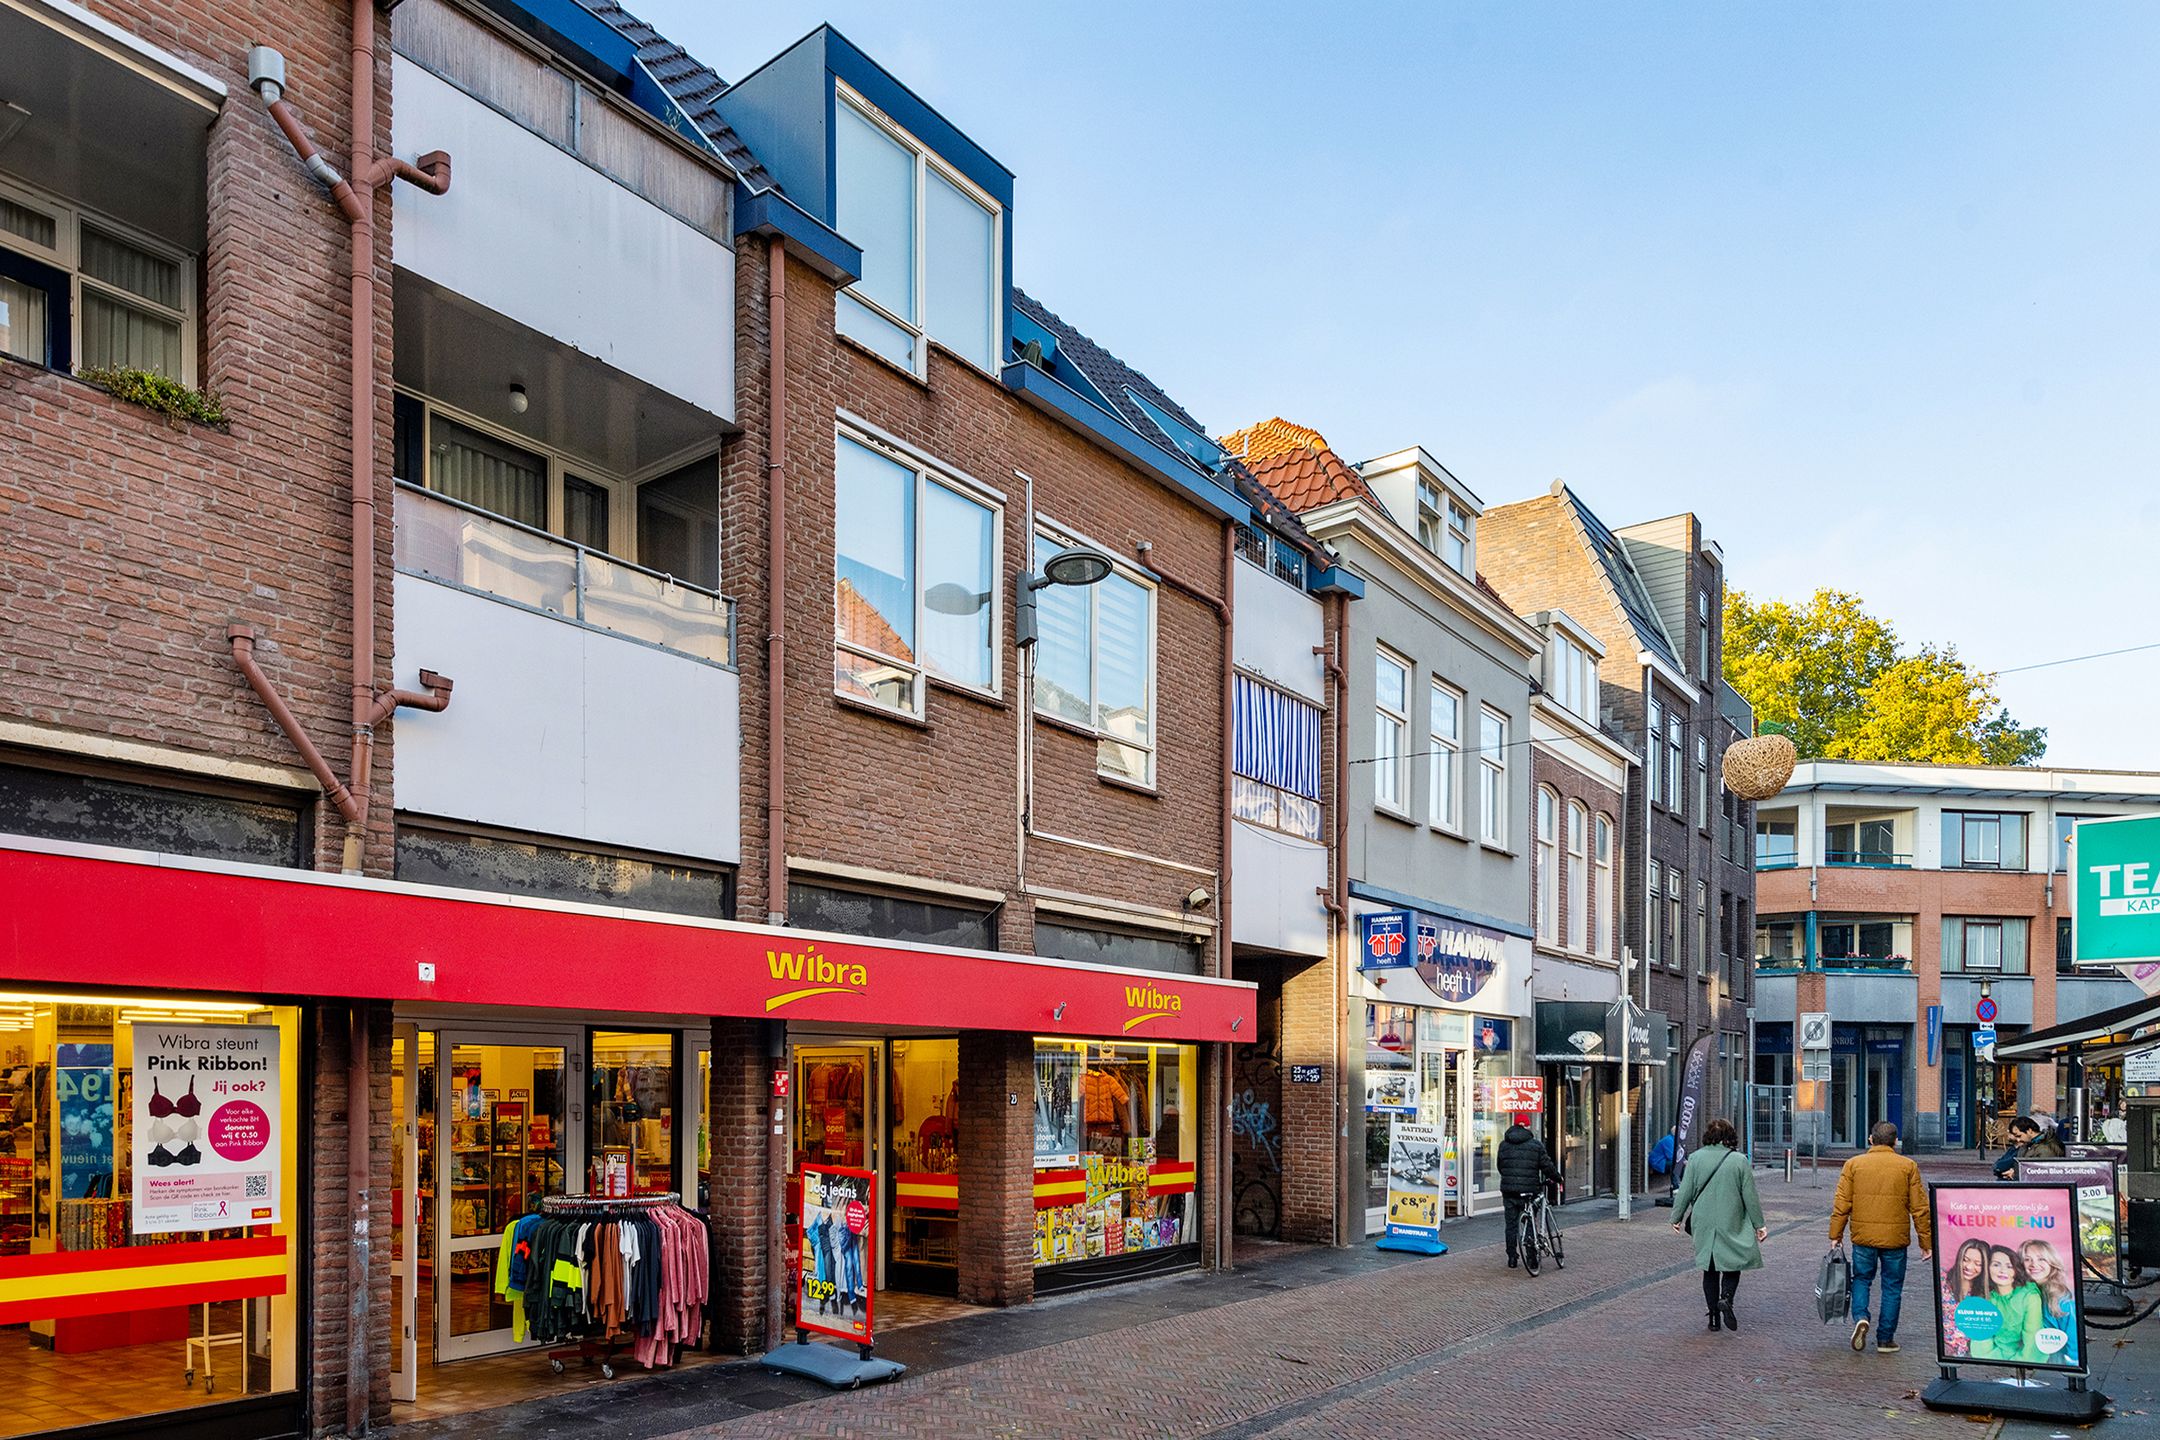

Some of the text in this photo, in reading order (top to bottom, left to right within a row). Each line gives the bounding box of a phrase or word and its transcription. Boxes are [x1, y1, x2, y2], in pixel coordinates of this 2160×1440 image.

[1371, 915, 1403, 923] HANDYMAN
[1440, 929, 1505, 963] HANDYM
[766, 945, 867, 986] Wibra
[1437, 966, 1463, 994] heeft
[1125, 981, 1182, 1011] Wibra
[158, 1034, 259, 1050] Wibra steunt
[148, 1055, 267, 1071] Pink Ribbon!
[212, 1080, 266, 1094] Jij ook?
[1501, 1079, 1539, 1089] SLEUTEL
[1502, 1101, 1538, 1111] SERVICE
[1036, 1124, 1050, 1132] Voor
[221, 1132, 233, 1140] wij
[241, 1131, 258, 1139] 0.50
[1036, 1134, 1056, 1142] stoere
[1397, 1134, 1438, 1143] VERVANGEN
[1035, 1141, 1050, 1151] kids
[1089, 1157, 1147, 1185] Wibra
[2064, 1167, 2097, 1175] Schnitzels
[829, 1181, 857, 1199] jeans
[2082, 1189, 2101, 1198] 5.00
[1950, 1201, 1967, 1211] Kies
[1979, 1203, 2001, 1214] jouw
[2002, 1203, 2049, 1214] persoonlijke
[1947, 1214, 2055, 1229] KLEUR ME-NU
[1398, 1228, 1428, 1237] HANDYMAN
[807, 1279, 834, 1300] 12.99
